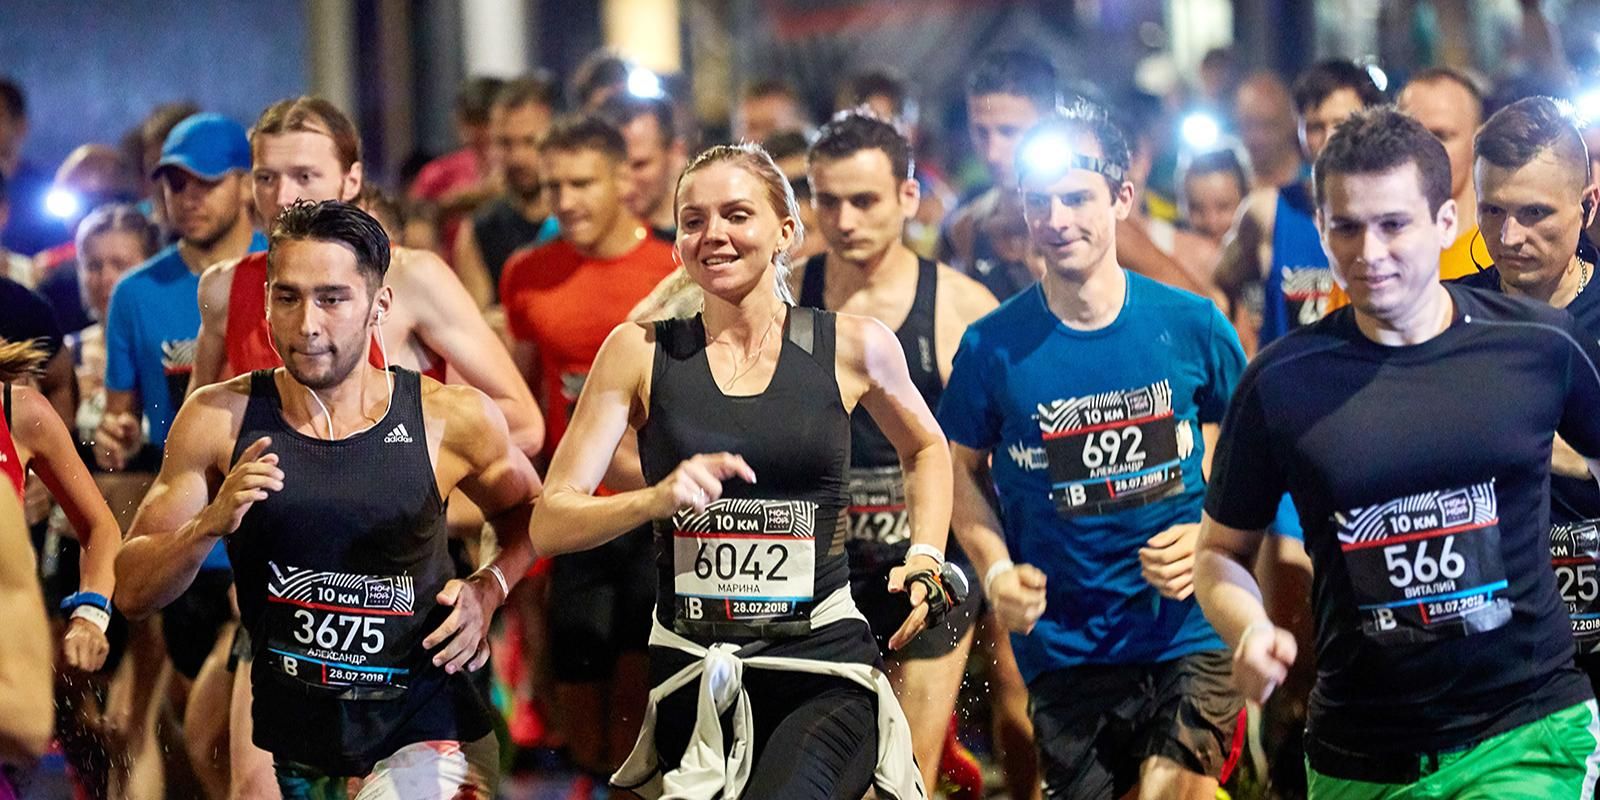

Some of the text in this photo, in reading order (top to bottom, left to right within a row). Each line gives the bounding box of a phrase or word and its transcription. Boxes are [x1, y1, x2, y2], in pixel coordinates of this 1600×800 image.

[1085, 409, 1101, 425] 10
[384, 435, 413, 443] adidas
[1082, 426, 1146, 468] 692
[715, 514, 734, 530] 10
[1390, 514, 1411, 534] 10
[694, 543, 789, 581] 6042
[1384, 535, 1466, 588] 566
[718, 584, 761, 593] МАРИНА
[1404, 580, 1457, 599] ВИТАЛИЙ
[1554, 565, 1599, 601] 25
[317, 587, 336, 602] 10
[733, 602, 788, 613] 28.07.2018
[293, 609, 386, 654] 3675
[1571, 619, 1600, 631] 7.2018
[307, 647, 368, 665] АЛЕКСАНДР
